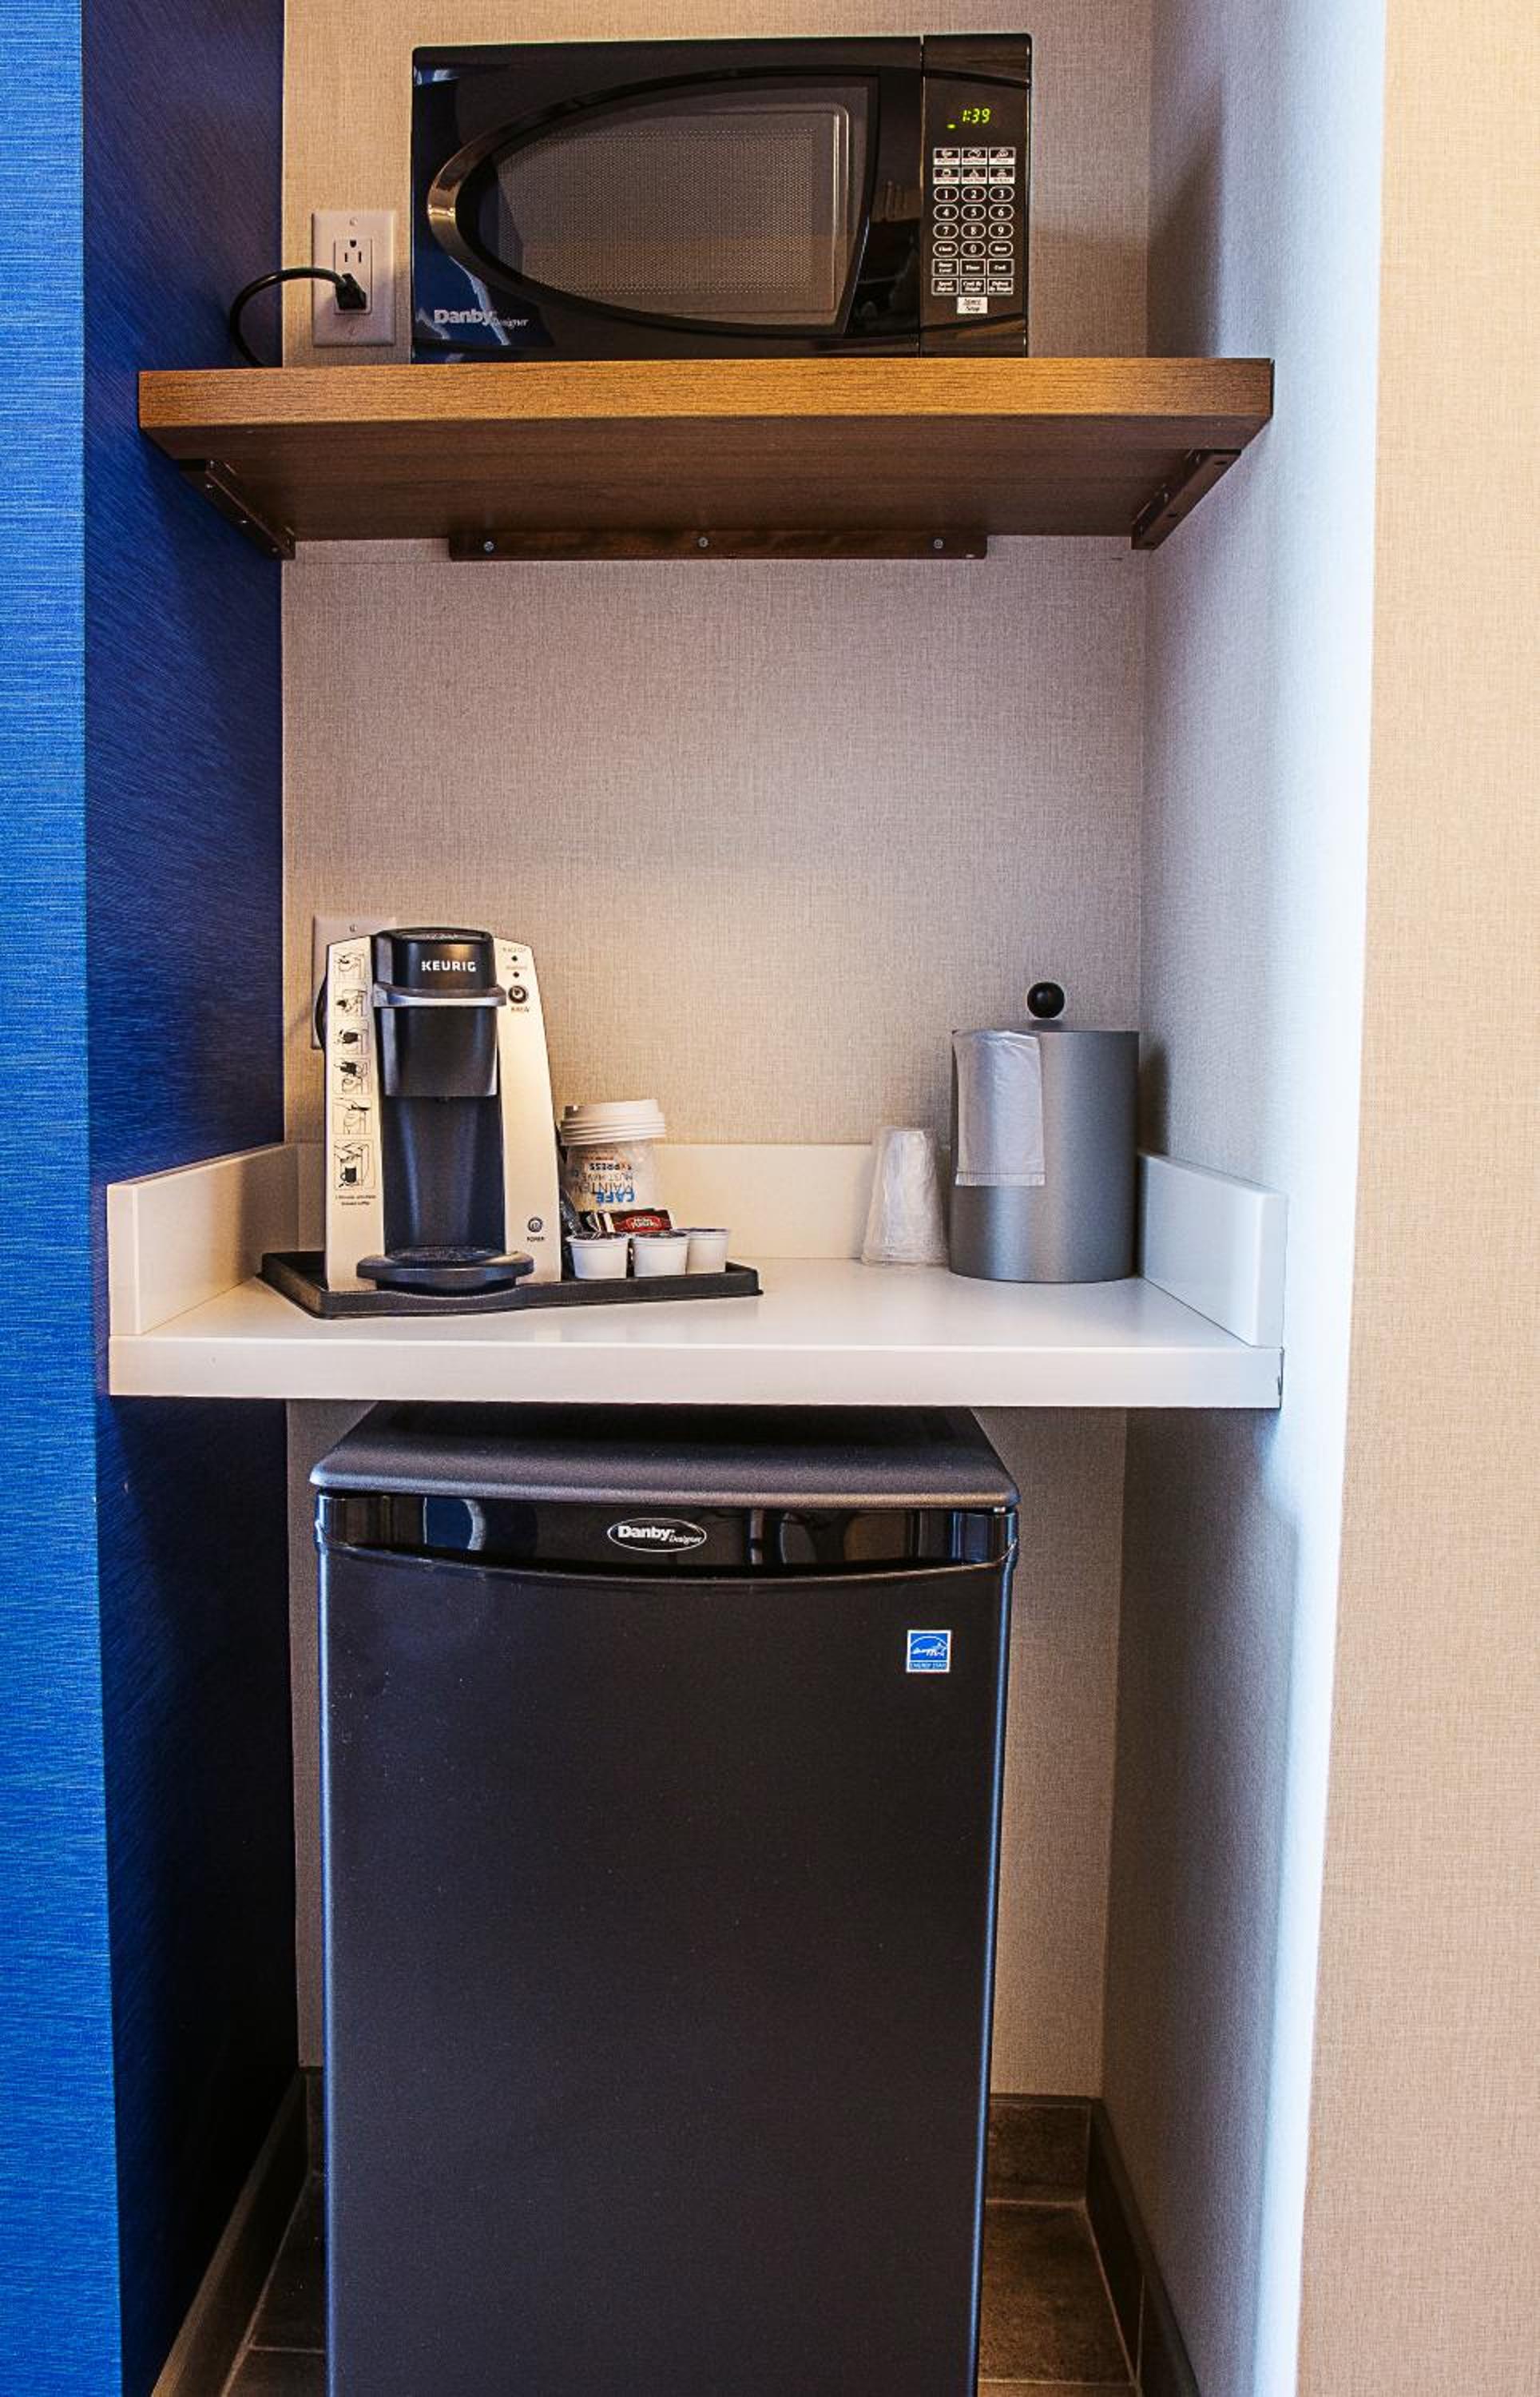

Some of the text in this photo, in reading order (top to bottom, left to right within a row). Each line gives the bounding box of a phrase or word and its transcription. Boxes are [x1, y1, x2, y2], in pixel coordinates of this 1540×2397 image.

[963, 108, 990, 123] 1:39
[970, 189, 977, 199] 2
[998, 189, 1004, 199] 3
[943, 207, 1004, 217] 4 5 6
[943, 226, 1004, 235] 7 8 9
[970, 244, 976, 253] 0
[434, 309, 494, 325] Danby
[421, 960, 477, 972] KEURIG
[617, 1525, 672, 1541] Danby
